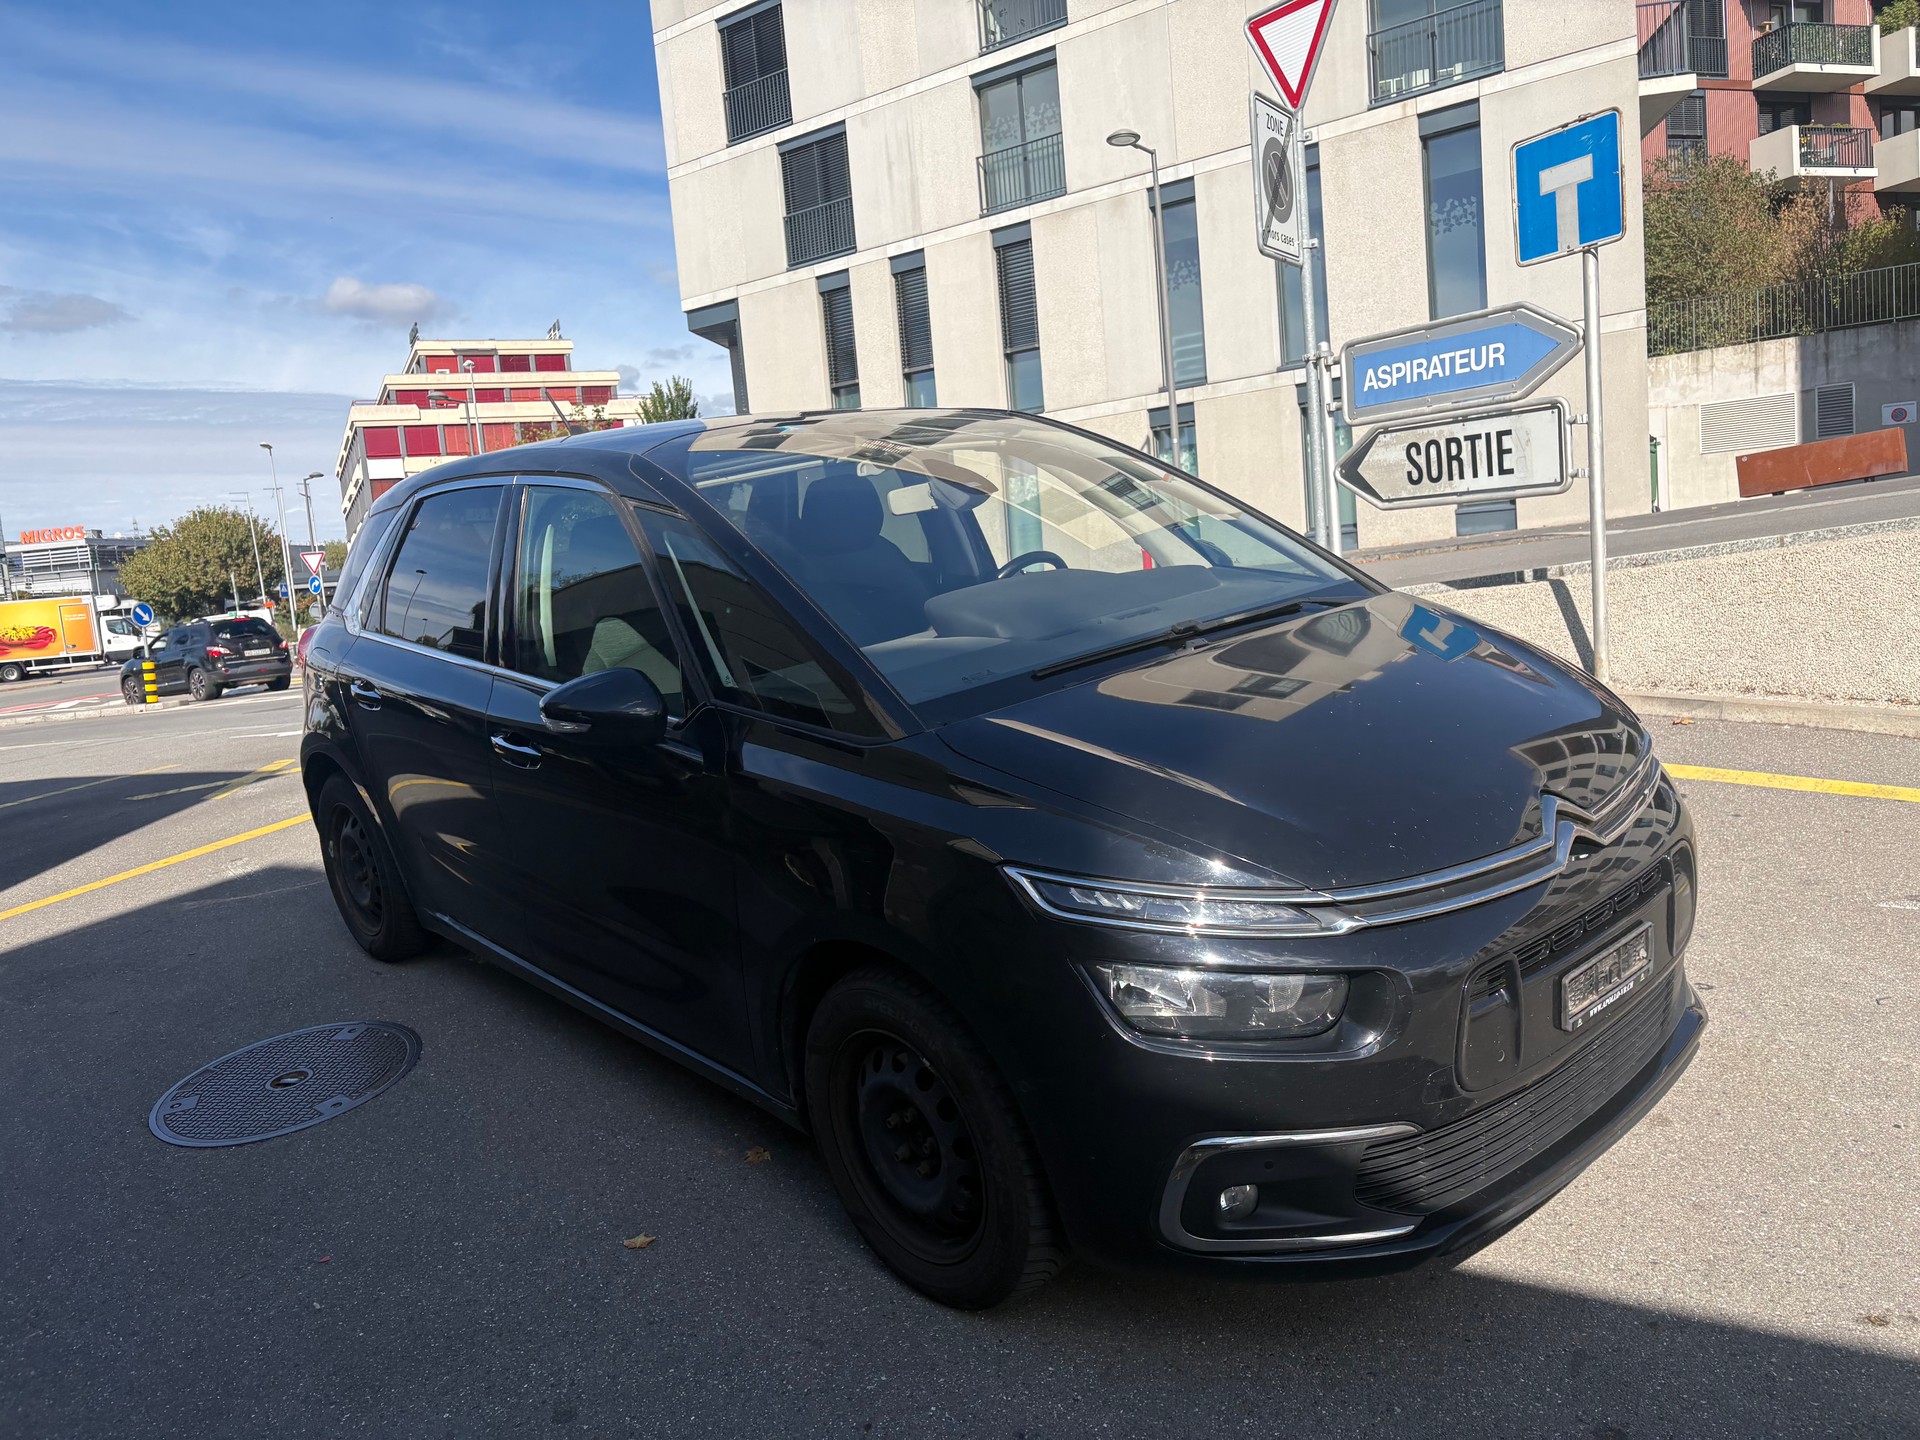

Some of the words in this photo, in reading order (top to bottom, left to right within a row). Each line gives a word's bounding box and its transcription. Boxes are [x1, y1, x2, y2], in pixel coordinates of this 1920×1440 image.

[1265, 112, 1285, 138] ZONE
[1363, 342, 1506, 392] ASPIRATEUR
[1405, 428, 1515, 487] SORTIE
[20, 524, 86, 545] MIGROS
